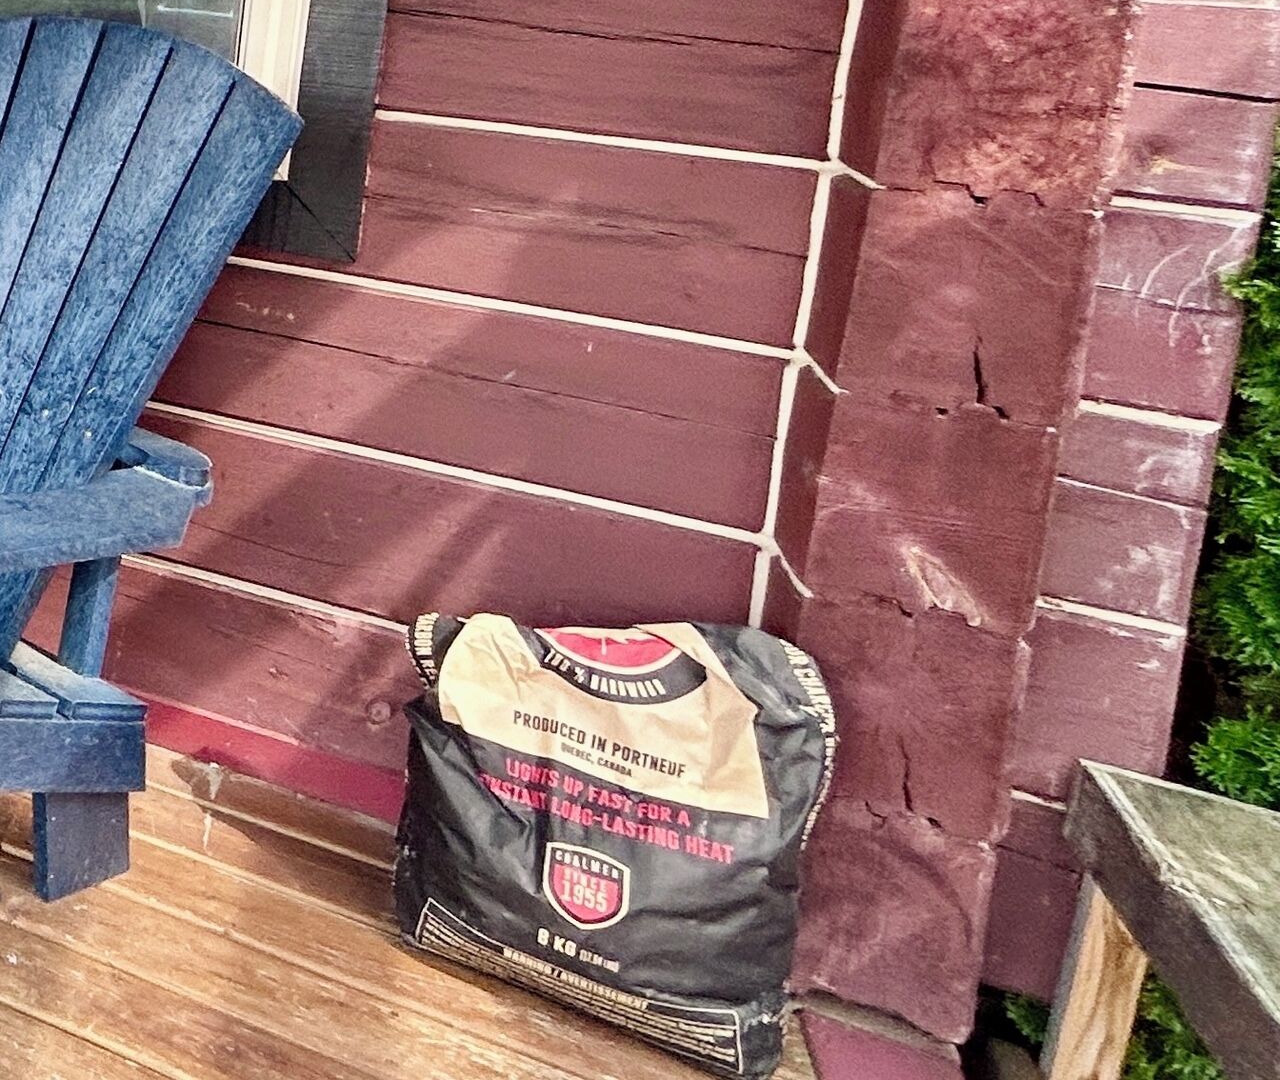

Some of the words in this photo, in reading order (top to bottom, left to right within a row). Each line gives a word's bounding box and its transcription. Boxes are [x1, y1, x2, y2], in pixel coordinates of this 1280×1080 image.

[543, 646, 569, 672] 100
[573, 666, 585, 684] %
[514, 710, 586, 744] PRODUCED
[591, 734, 608, 753] IN
[611, 741, 686, 779] PORTNEUF
[597, 757, 633, 777] CANADA
[506, 758, 560, 788] LIGHTS
[563, 774, 584, 798] UP
[588, 783, 633, 813] FAST
[637, 801, 672, 823] FOR
[676, 810, 691, 827] A
[551, 796, 680, 851] LONG-LASTING
[686, 834, 735, 865] HEAT
[560, 881, 608, 913] 1955
[563, 867, 608, 893] SINCE
[553, 935, 577, 957] KG
